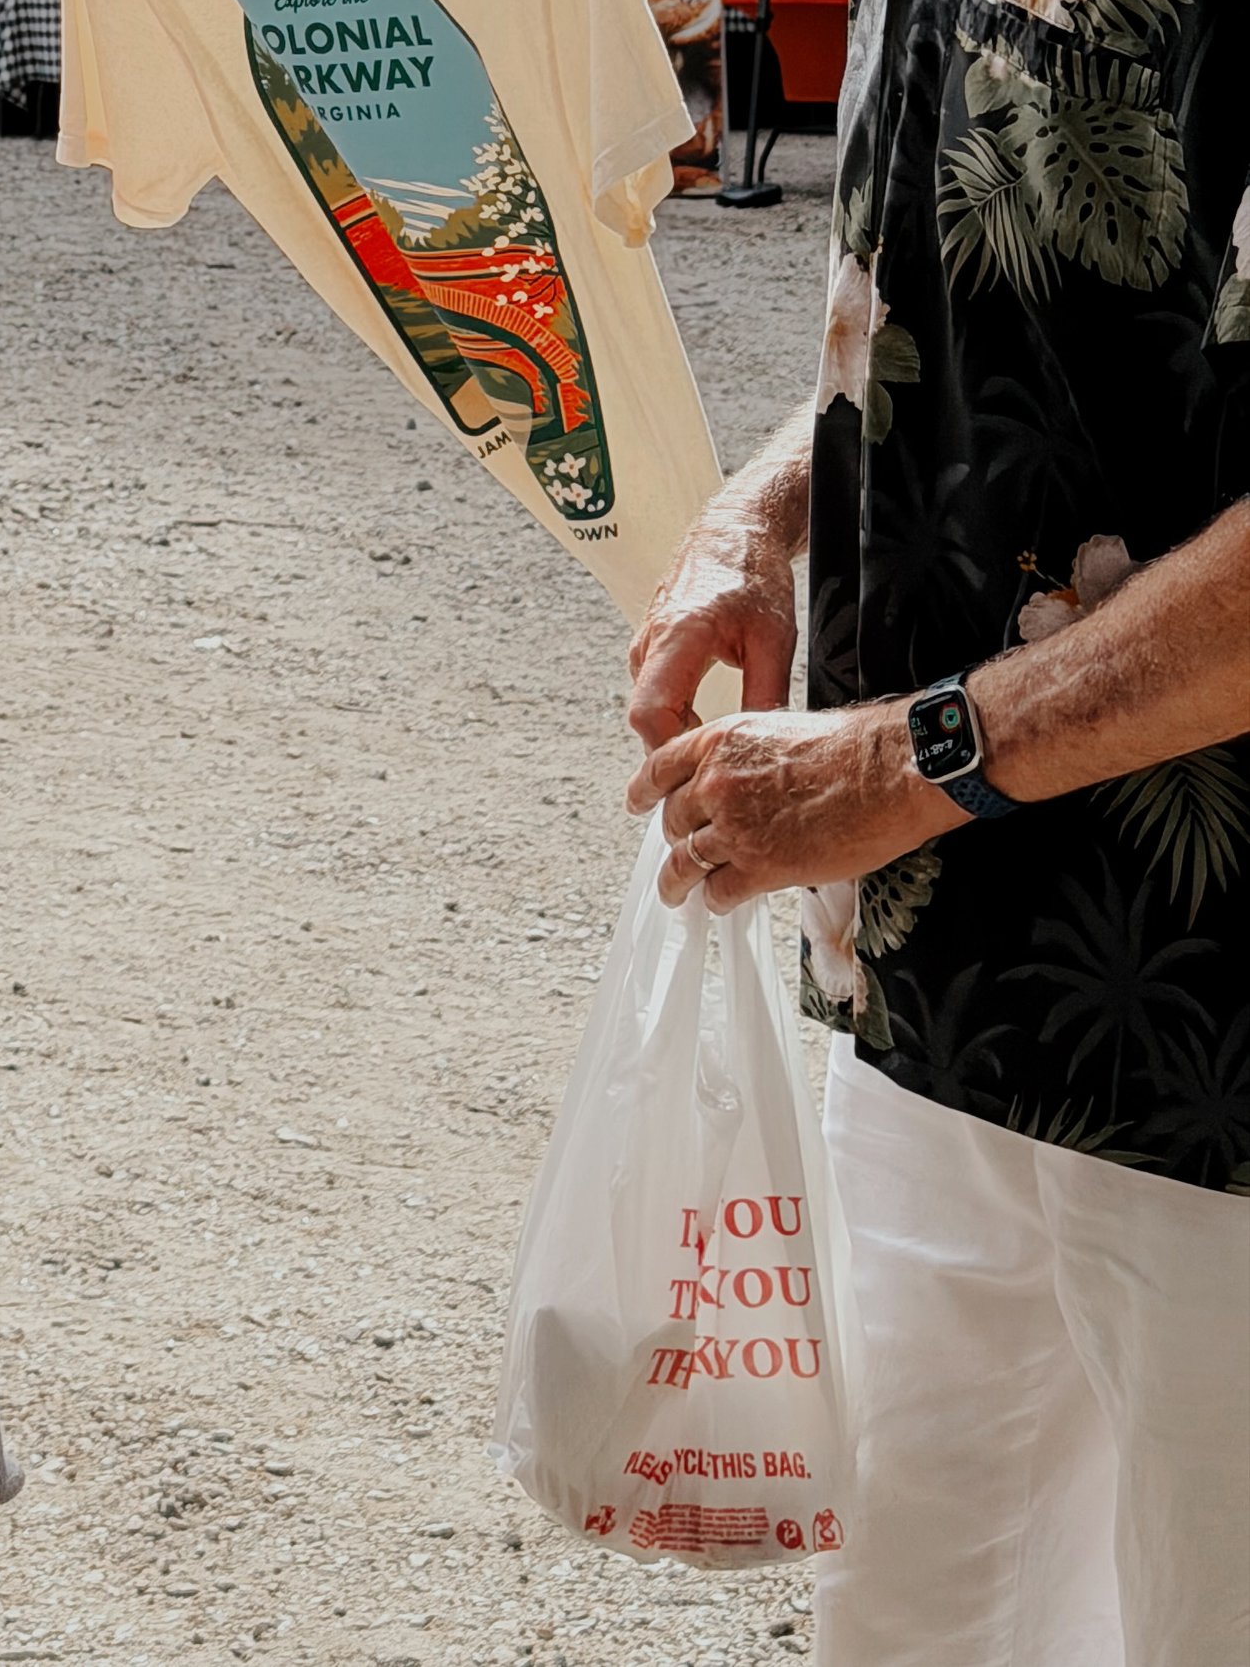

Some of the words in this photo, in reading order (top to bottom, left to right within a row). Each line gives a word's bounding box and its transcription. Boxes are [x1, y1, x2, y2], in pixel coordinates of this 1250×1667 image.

[261, 15, 433, 55] OLONIAL
[292, 56, 434, 95] RKWAY
[315, 102, 401, 122] RGINIA
[570, 523, 619, 542] OWN
[713, 1338, 822, 1380] YOU
[709, 1451, 757, 1479] THIS
[762, 1451, 812, 1479] BAG.
